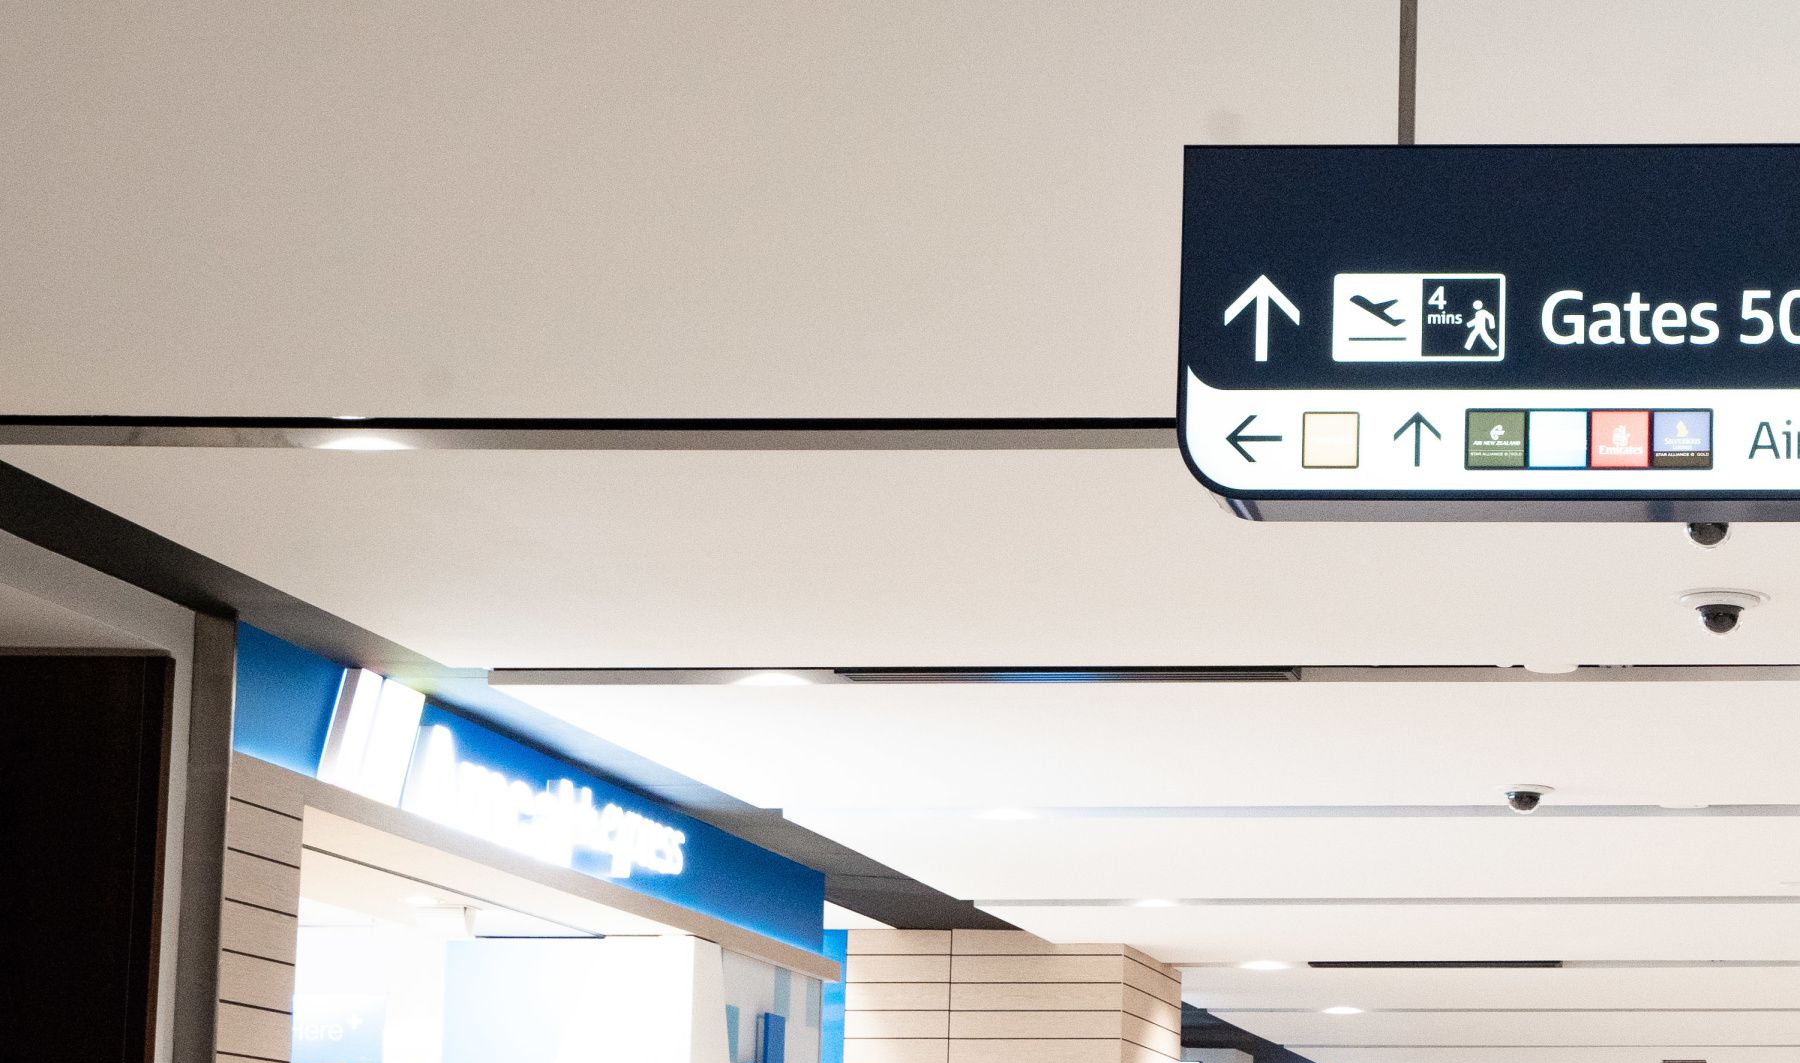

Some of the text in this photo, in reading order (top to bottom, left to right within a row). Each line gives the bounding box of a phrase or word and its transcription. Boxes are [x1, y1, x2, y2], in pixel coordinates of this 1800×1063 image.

[1428, 286, 1447, 310] 4
[1428, 311, 1463, 325] mins
[1542, 290, 1719, 345] Gates
[1598, 446, 1643, 455] Emirates
